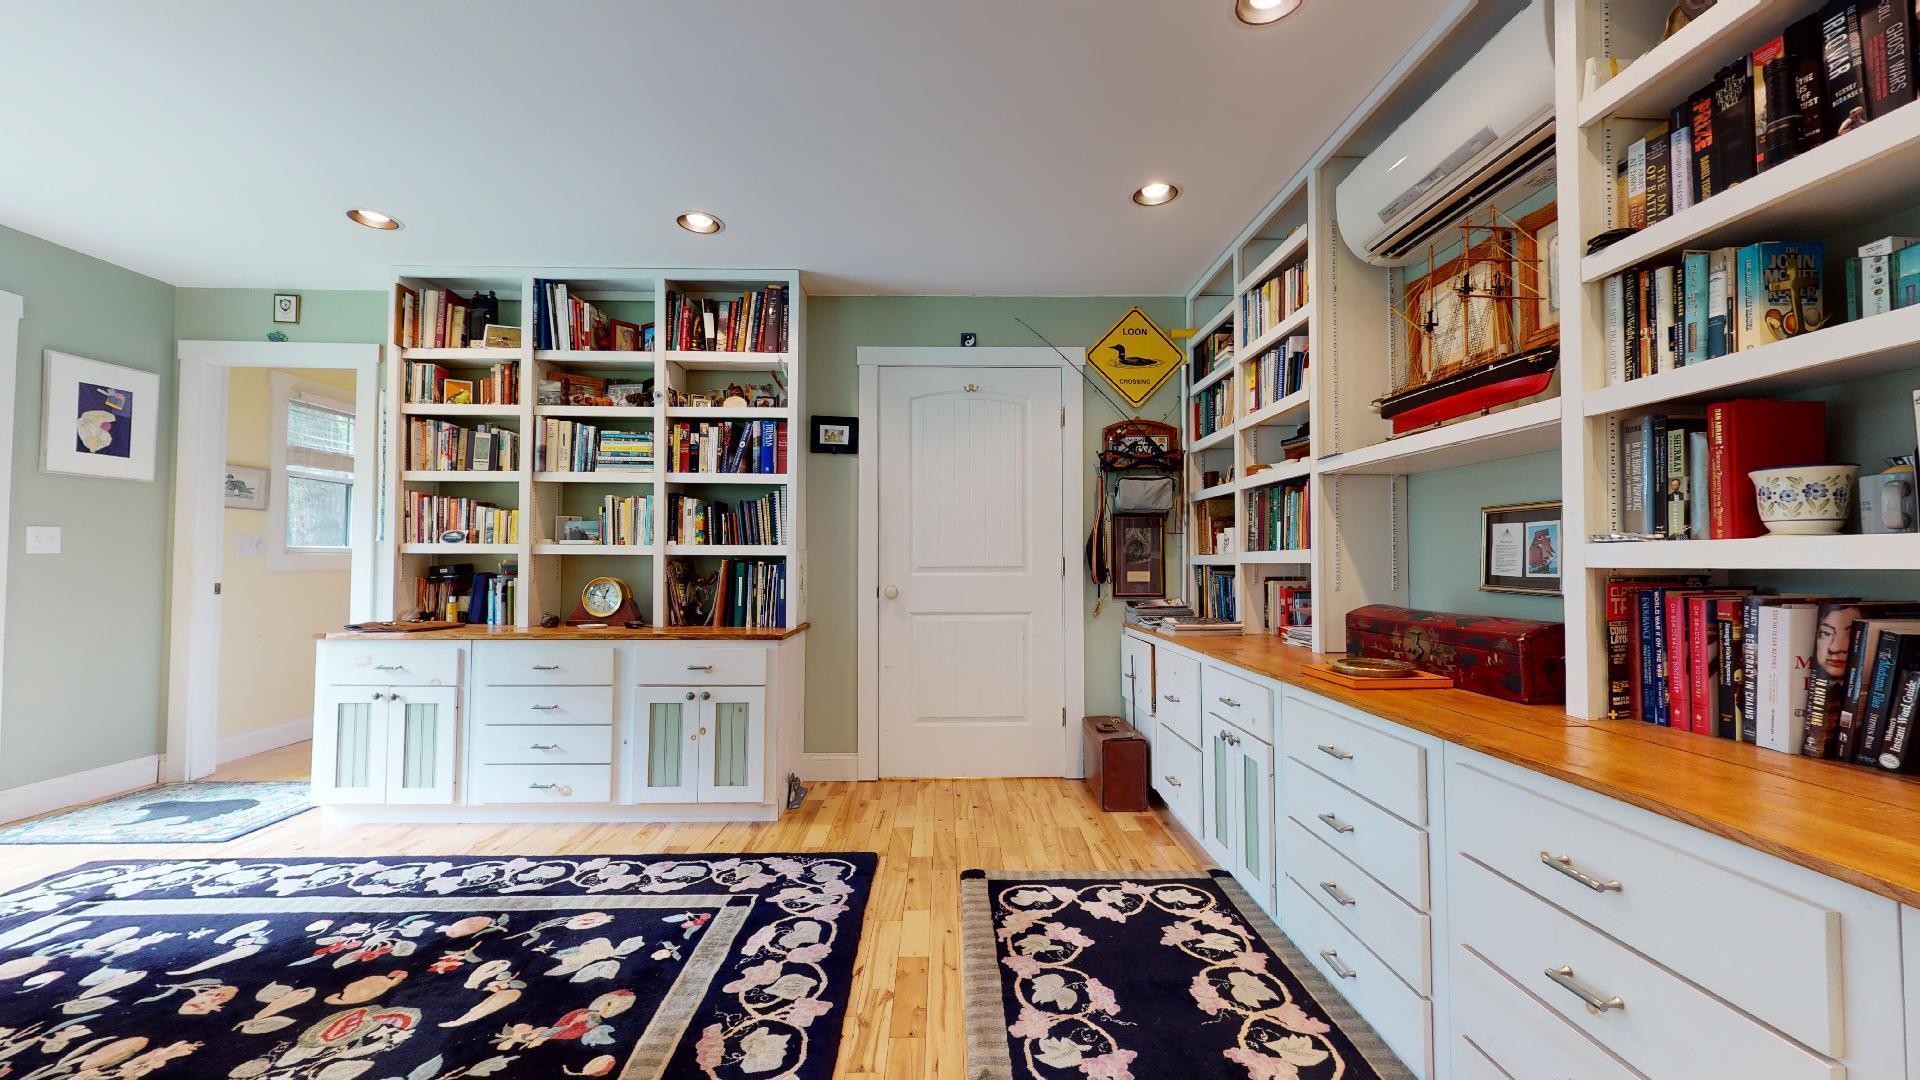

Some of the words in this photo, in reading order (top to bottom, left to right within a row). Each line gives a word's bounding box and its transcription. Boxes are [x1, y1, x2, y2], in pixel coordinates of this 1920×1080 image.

[1822, 11, 1848, 51] IRAQ
[1886, 22, 1905, 60] GHOST
[1826, 44, 1851, 81] WAR
[1889, 59, 1908, 94] WARS
[1693, 97, 1712, 153] PRIZE
[1647, 165, 1656, 180] OF
[1657, 165, 1666, 191] THE
[1647, 184, 1656, 227] BATTLE
[1658, 193, 1666, 216] DAY
[1122, 328, 1148, 336] LOON
[765, 423, 774, 447] TRUMAN
[1674, 434, 1682, 473] SHERMAN
[1642, 597, 1651, 640] ENDURANCE
[1671, 603, 1676, 613] ON
[1694, 606, 1699, 616] ON
[1656, 637, 1661, 649] ON
[1745, 633, 1755, 679] DEMOCRACY
[1672, 661, 1680, 694] DOORSTEP
[1724, 660, 1732, 686] Supremacy
[1745, 681, 1754, 690] IN
[1874, 659, 1890, 692] Madonna
[1871, 691, 1885, 708] Files
[1902, 679, 1918, 704] Guide
[1745, 691, 1754, 720] CHAINS
[1897, 703, 1912, 726] Word
[1866, 712, 1880, 735] STEPHEN
[1885, 718, 1896, 742] Webster's
[1864, 734, 1875, 749] RYAN
[1890, 725, 1906, 753] Instant
